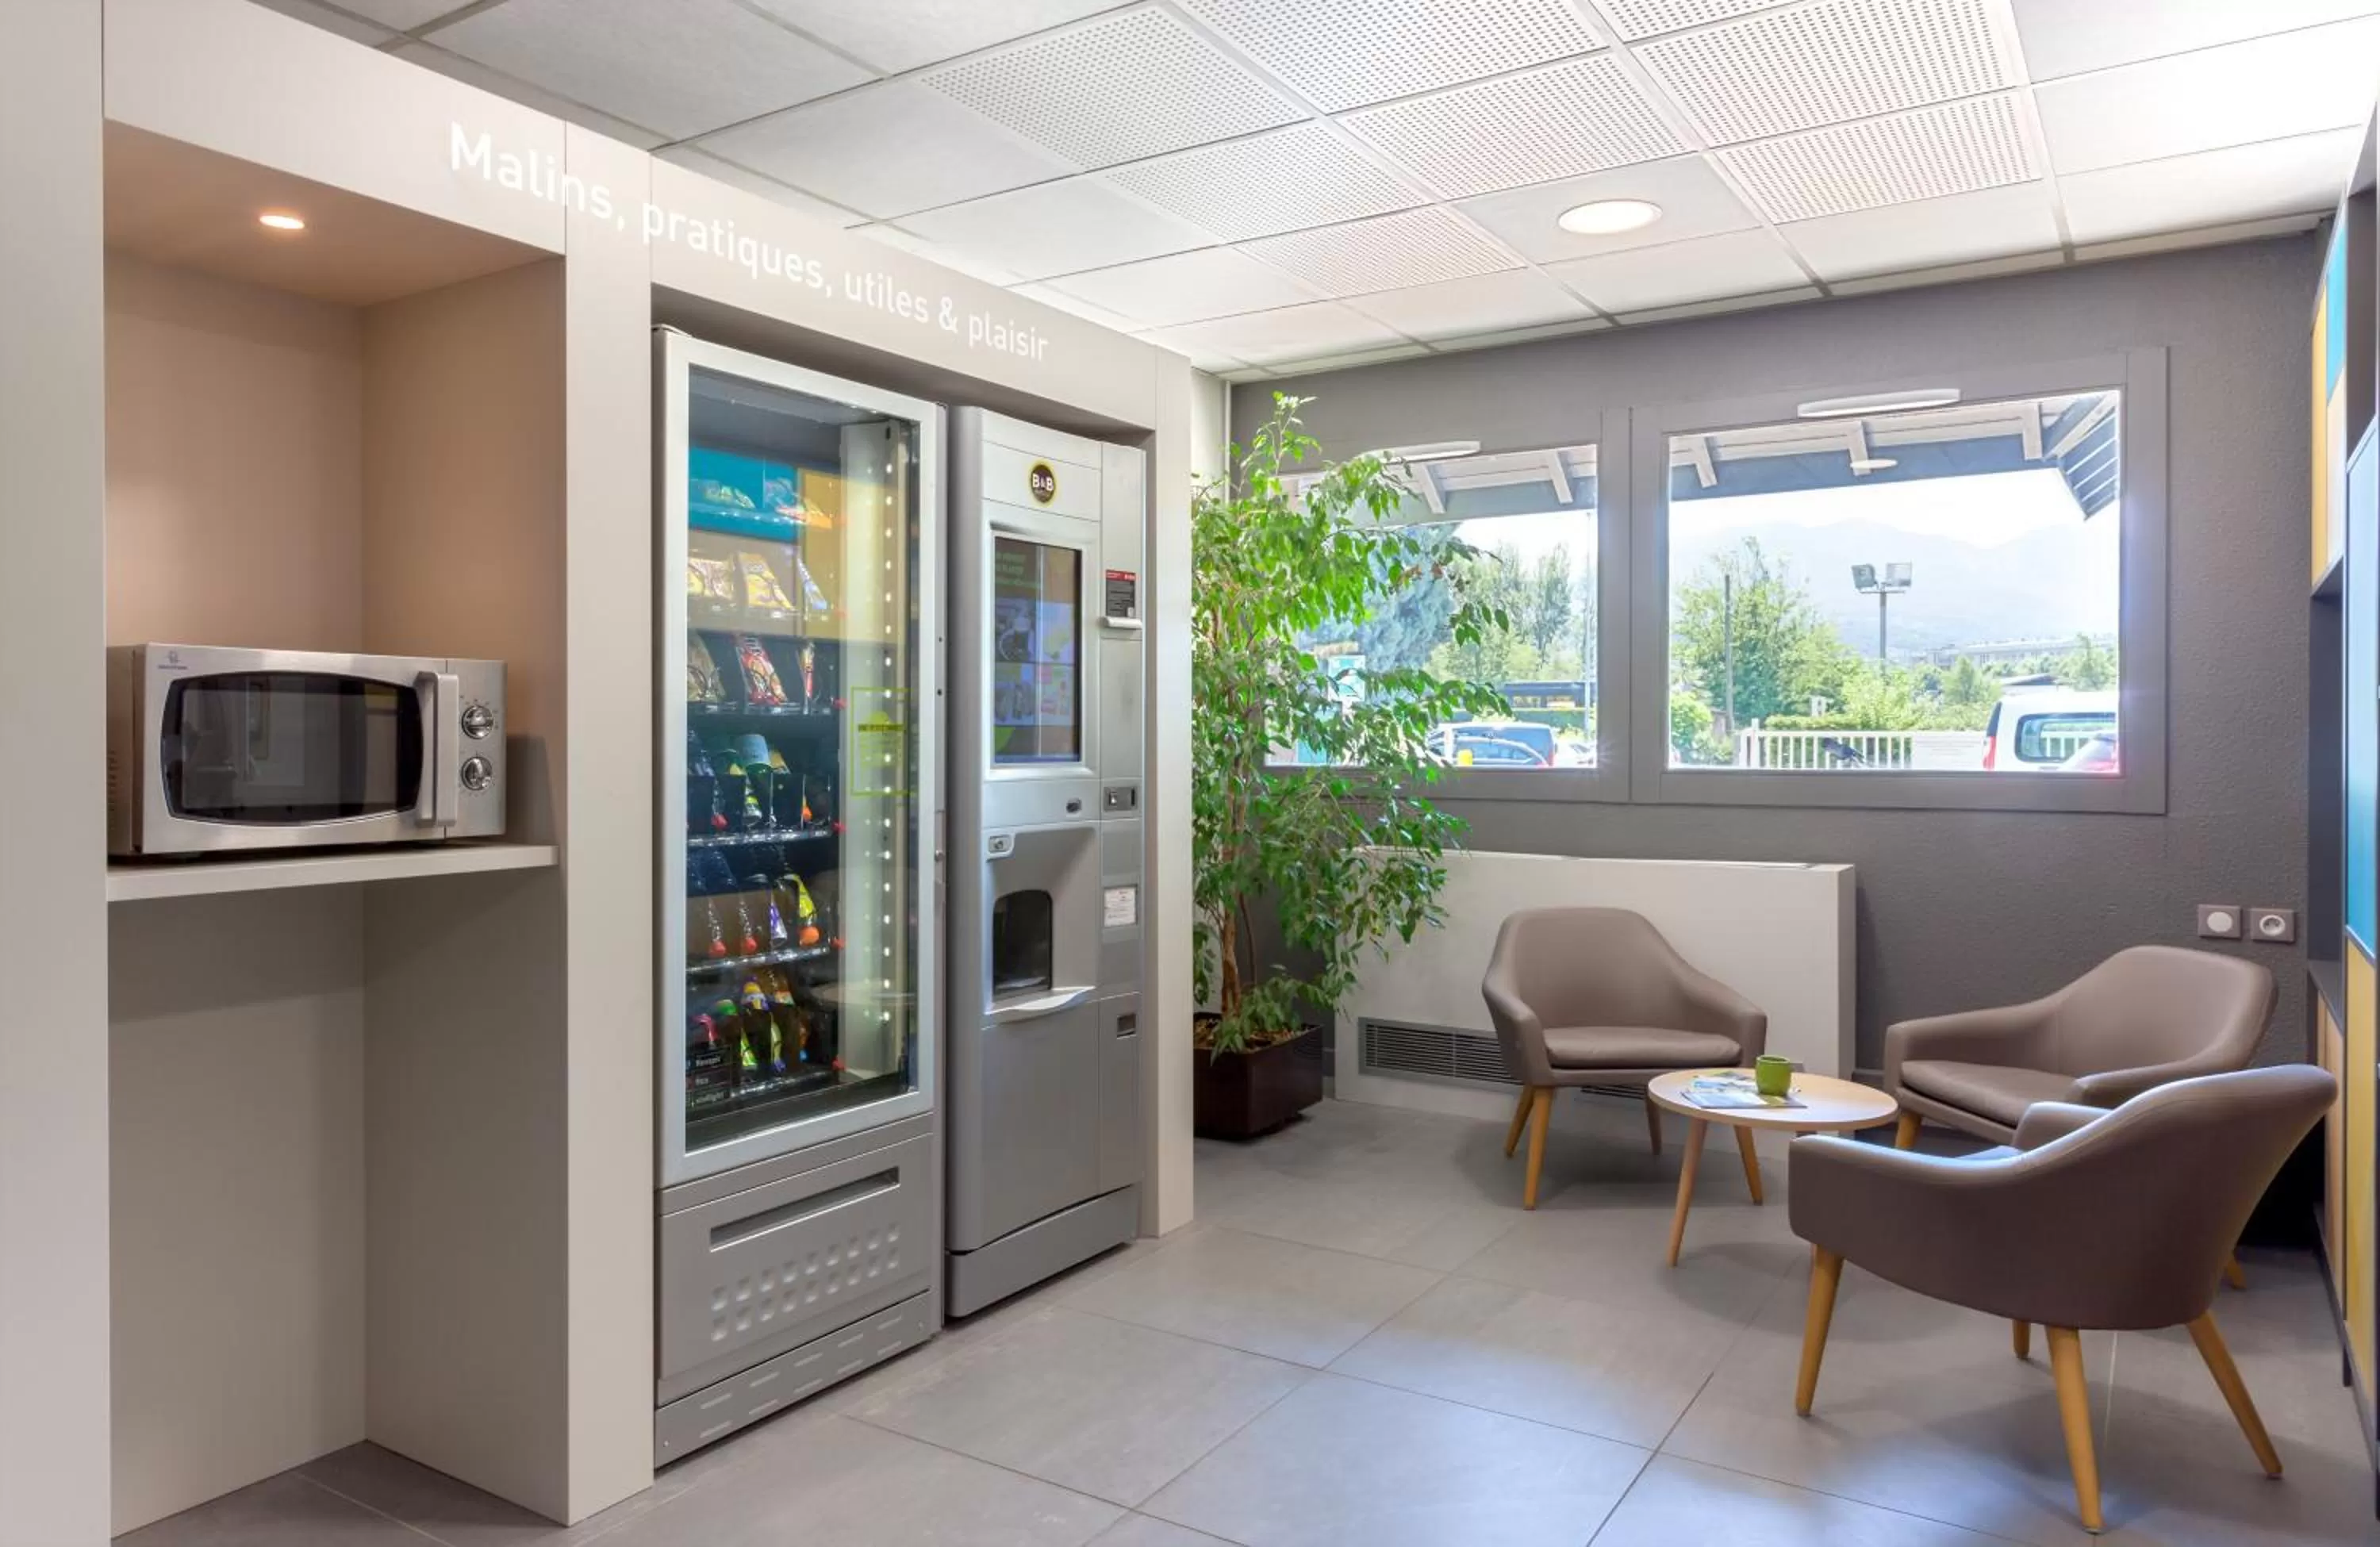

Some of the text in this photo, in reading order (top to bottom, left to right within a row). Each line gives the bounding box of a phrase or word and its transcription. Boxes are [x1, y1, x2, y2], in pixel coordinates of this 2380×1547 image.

[451, 121, 1049, 362] Malins, pratiques, utiles & plaisir
